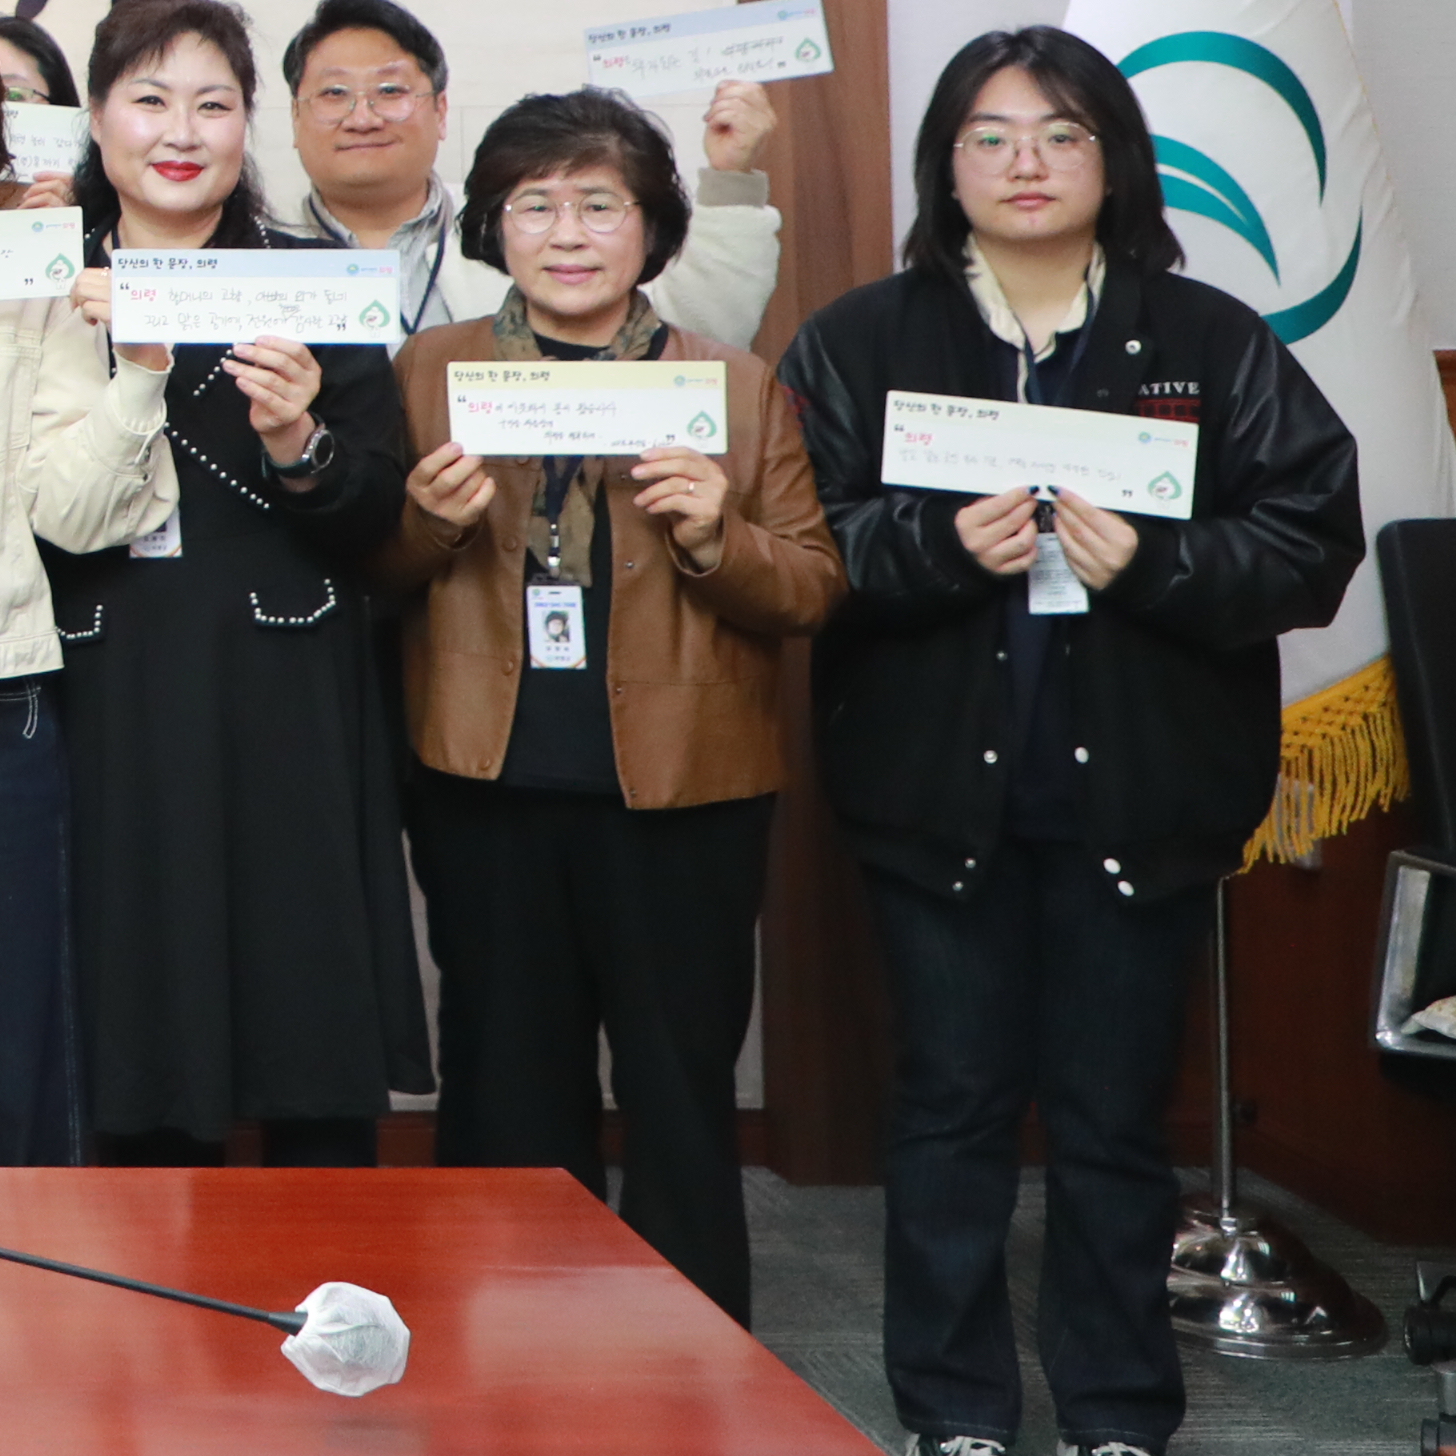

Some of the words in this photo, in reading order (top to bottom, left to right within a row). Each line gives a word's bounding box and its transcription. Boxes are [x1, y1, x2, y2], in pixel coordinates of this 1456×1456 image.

[118, 258, 149, 269] 당신의
[154, 258, 163, 269] 한
[168, 258, 192, 269] 문장,
[197, 258, 217, 269] 의령
[130, 289, 157, 301] 의령
